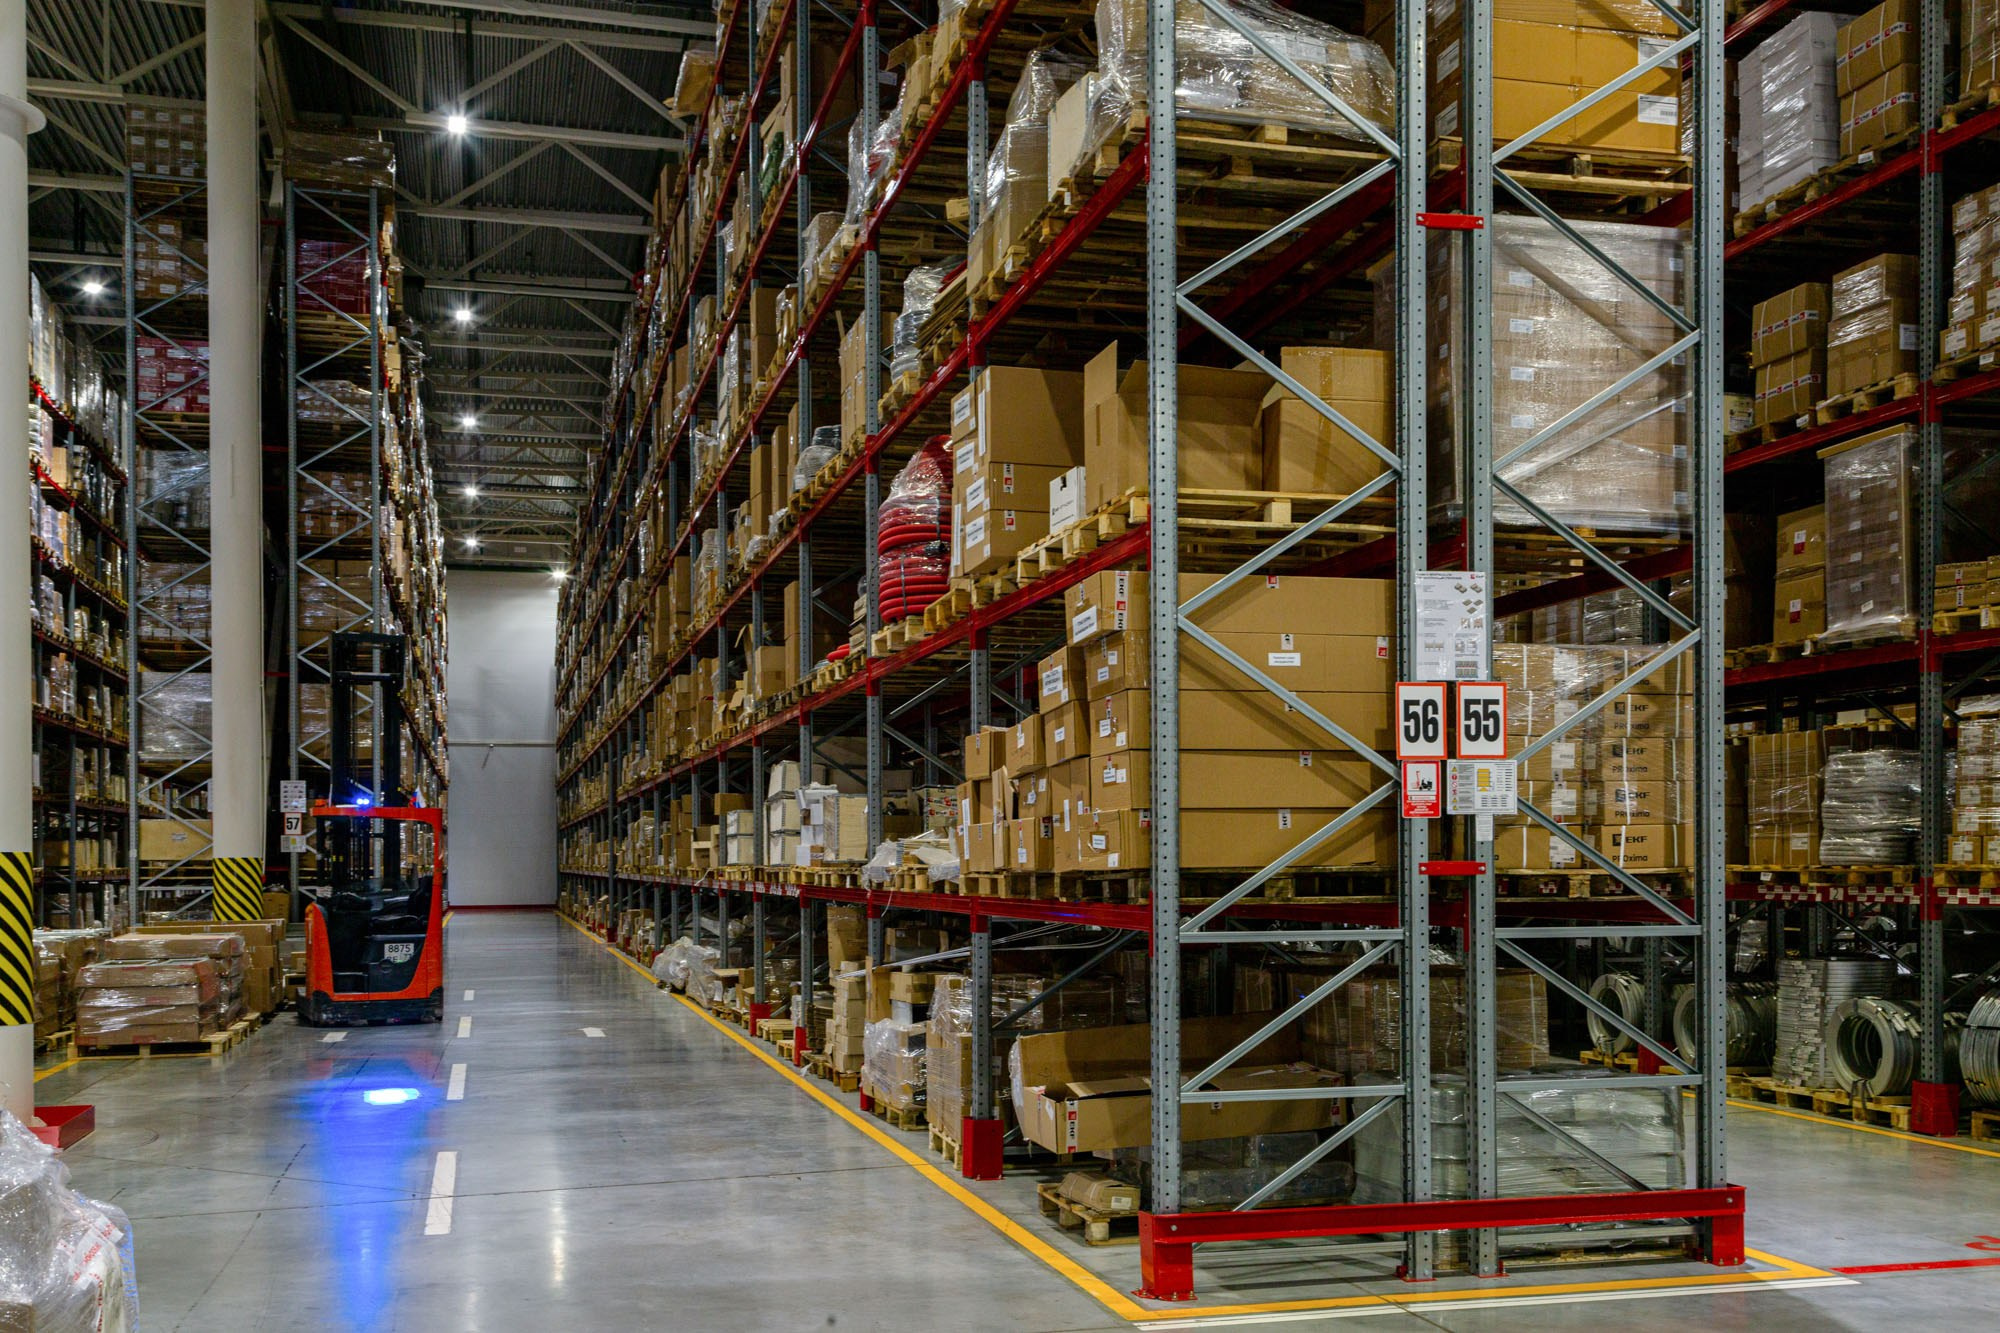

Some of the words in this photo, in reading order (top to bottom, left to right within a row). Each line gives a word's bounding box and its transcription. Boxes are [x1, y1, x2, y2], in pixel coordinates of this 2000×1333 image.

[1403, 698, 1440, 744] 56
[1463, 698, 1501, 744] 55
[1612, 765, 1648, 773] PRxima
[286, 817, 300, 831] 57
[1625, 835, 1648, 843] EKF
[388, 944, 411, 953] 8875
